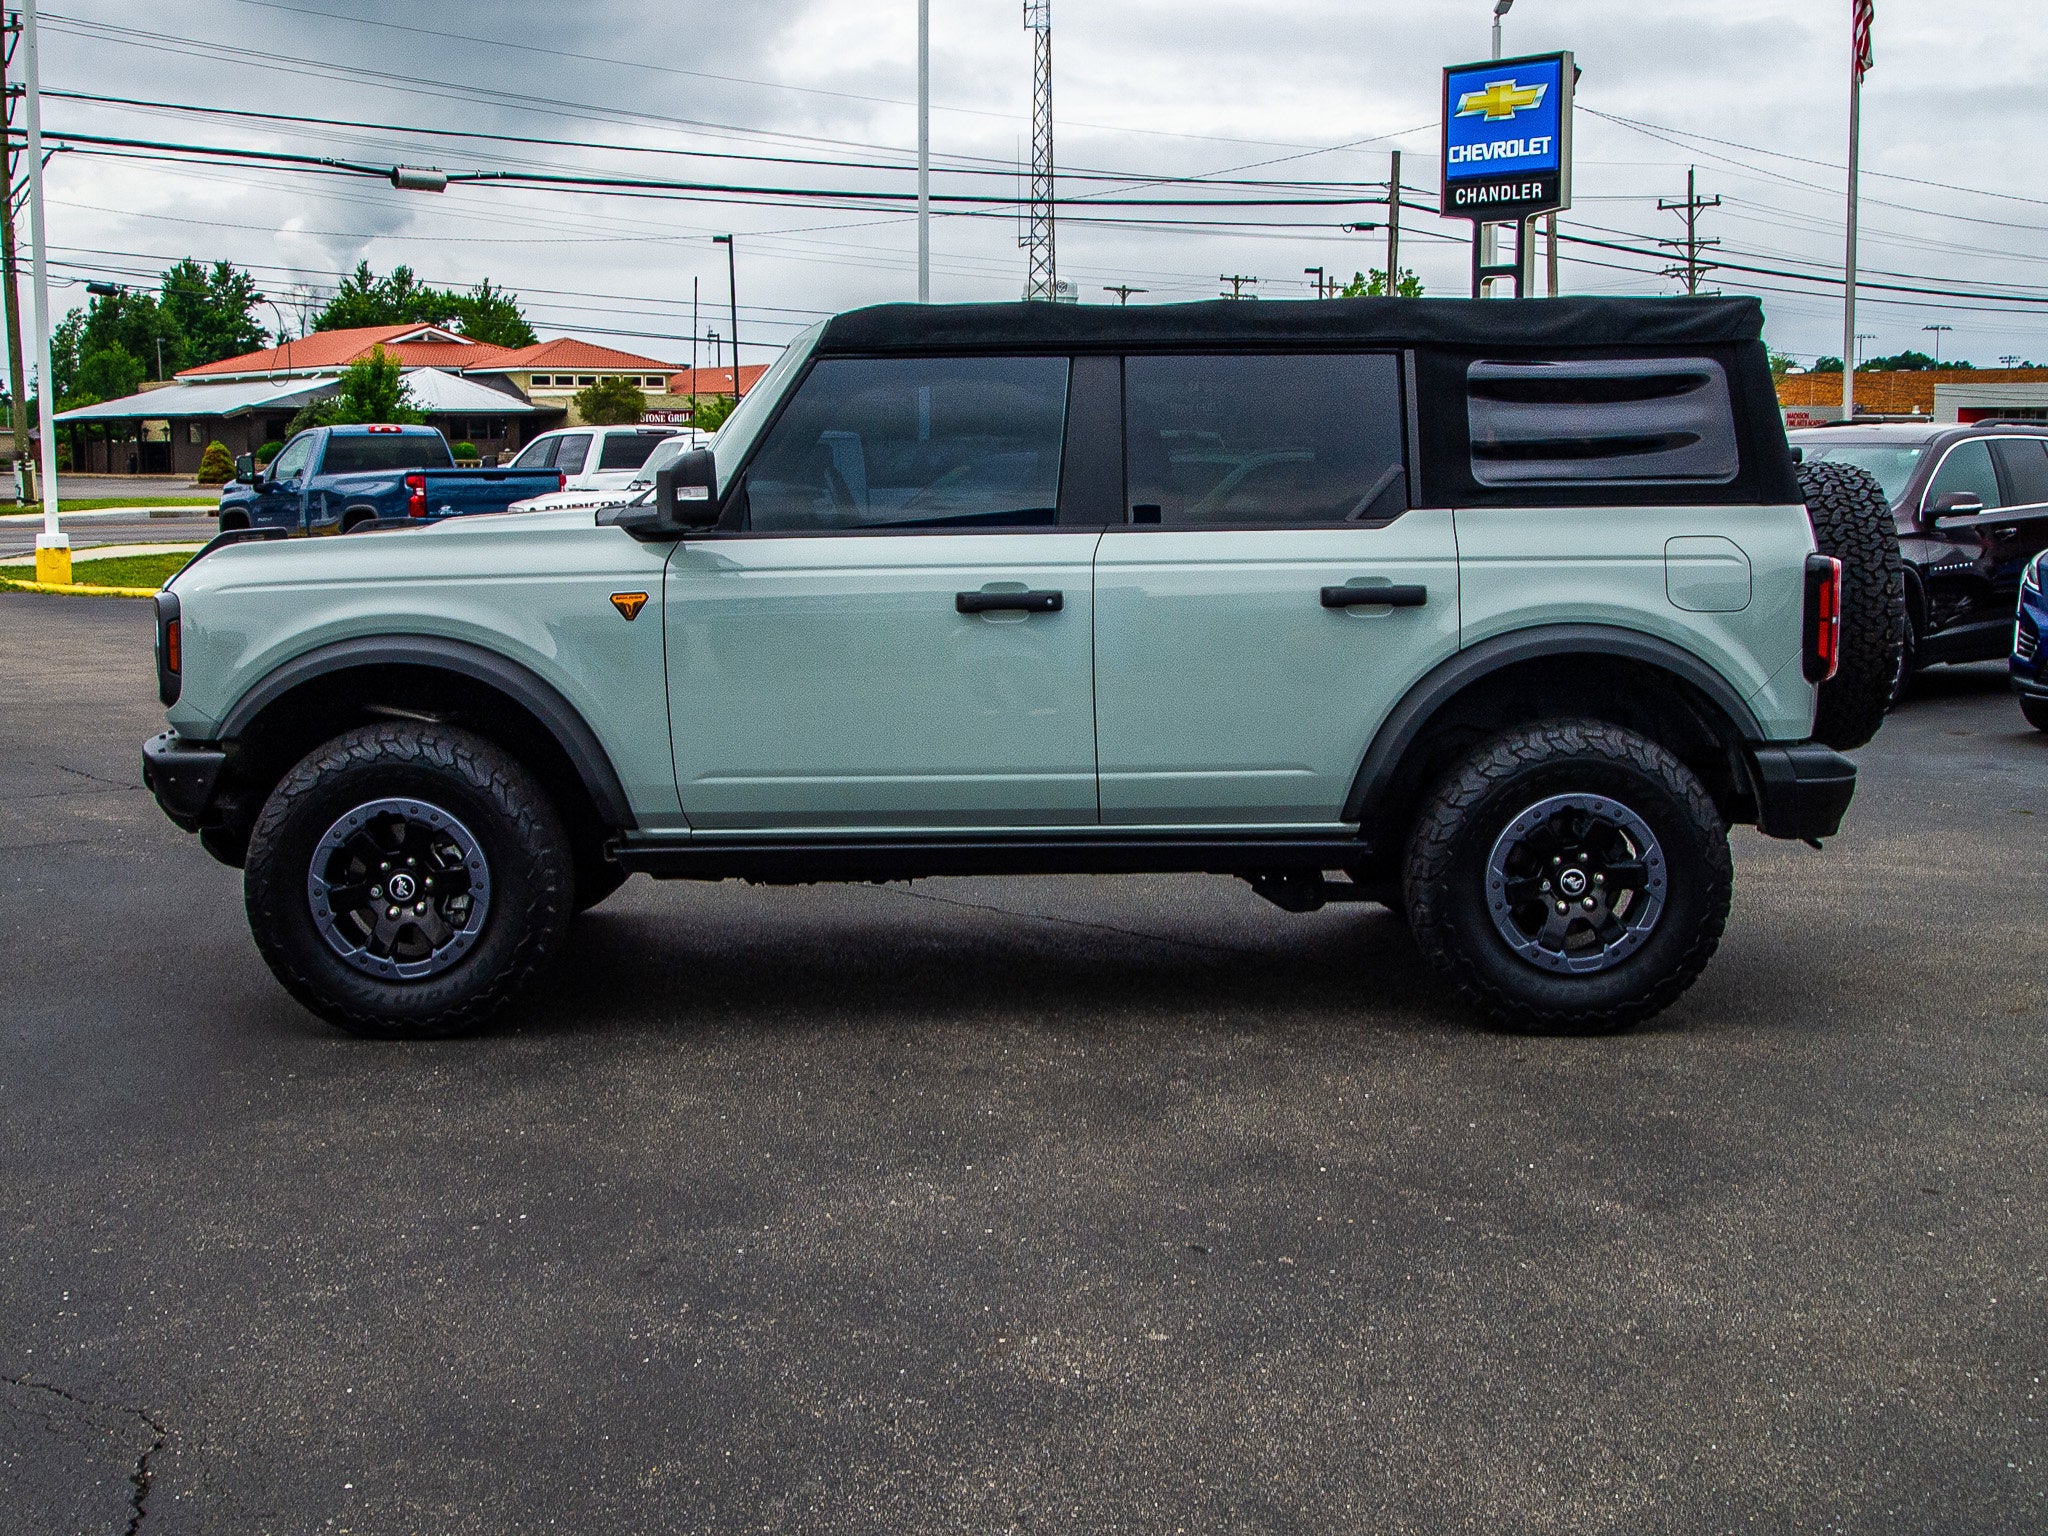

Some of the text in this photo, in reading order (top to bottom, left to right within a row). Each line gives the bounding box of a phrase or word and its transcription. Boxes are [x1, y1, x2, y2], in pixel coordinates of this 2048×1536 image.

[1449, 136, 1551, 163] CHEVROLET
[1455, 182, 1542, 204] CHANDLER
[640, 412, 665, 422] STONE
